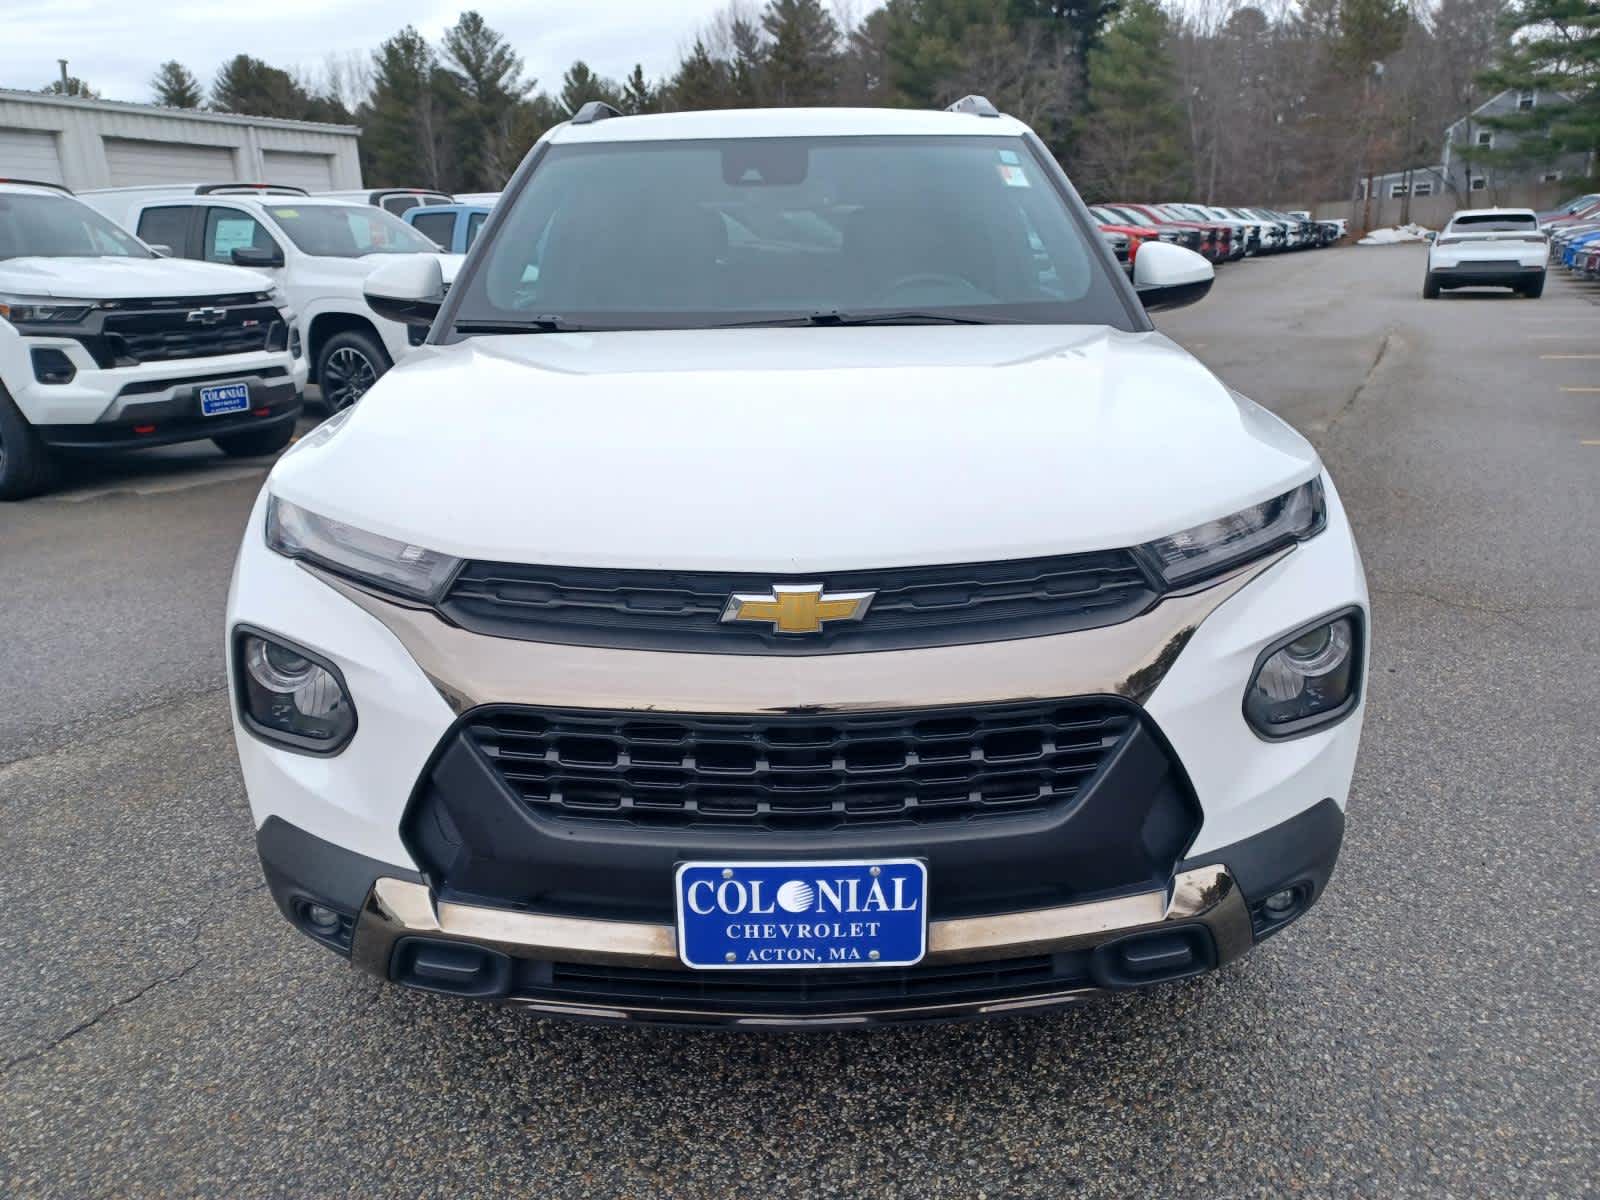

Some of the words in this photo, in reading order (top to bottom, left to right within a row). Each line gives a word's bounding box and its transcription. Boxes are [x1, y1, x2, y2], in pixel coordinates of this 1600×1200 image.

[726, 922, 881, 939] CHEVROLET
[746, 948, 822, 963] ACTON,
[829, 947, 861, 960] MA
